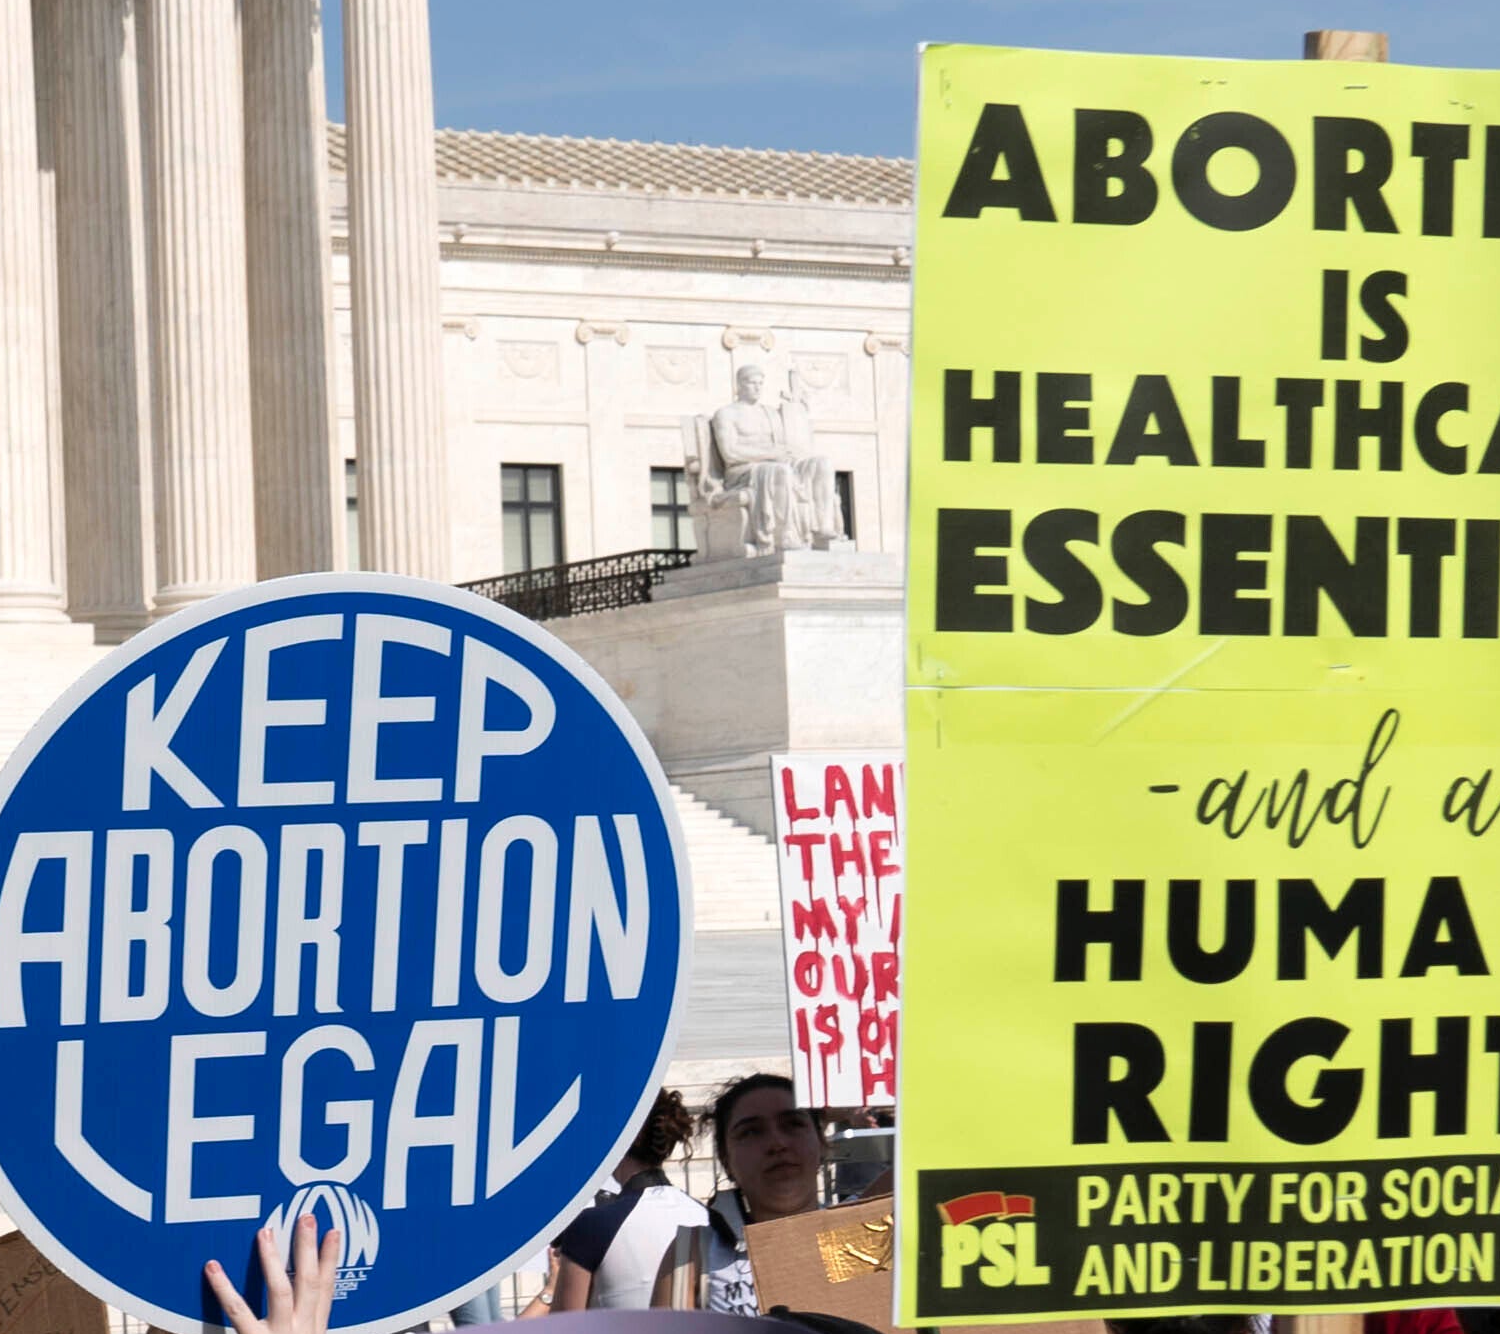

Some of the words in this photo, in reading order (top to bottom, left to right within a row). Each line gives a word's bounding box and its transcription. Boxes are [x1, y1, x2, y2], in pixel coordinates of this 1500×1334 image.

[1320, 269, 1410, 363] IS
[121, 613, 556, 811] KEEP
[782, 764, 903, 821] LAN
[784, 831, 900, 881] THE
[792, 895, 868, 944] MY
[796, 1004, 844, 1055] IS
[55, 1015, 581, 1224] LEGAL
[263, 1185, 380, 1269] NOW
[1077, 1174, 1255, 1227] PARTY
[1269, 1172, 1368, 1224] FOR
[939, 1222, 1050, 1288] PSL
[1073, 1242, 1183, 1297] AND
[1198, 1232, 1496, 1294] LIBERATION
[724, 1280, 755, 1301] MY
